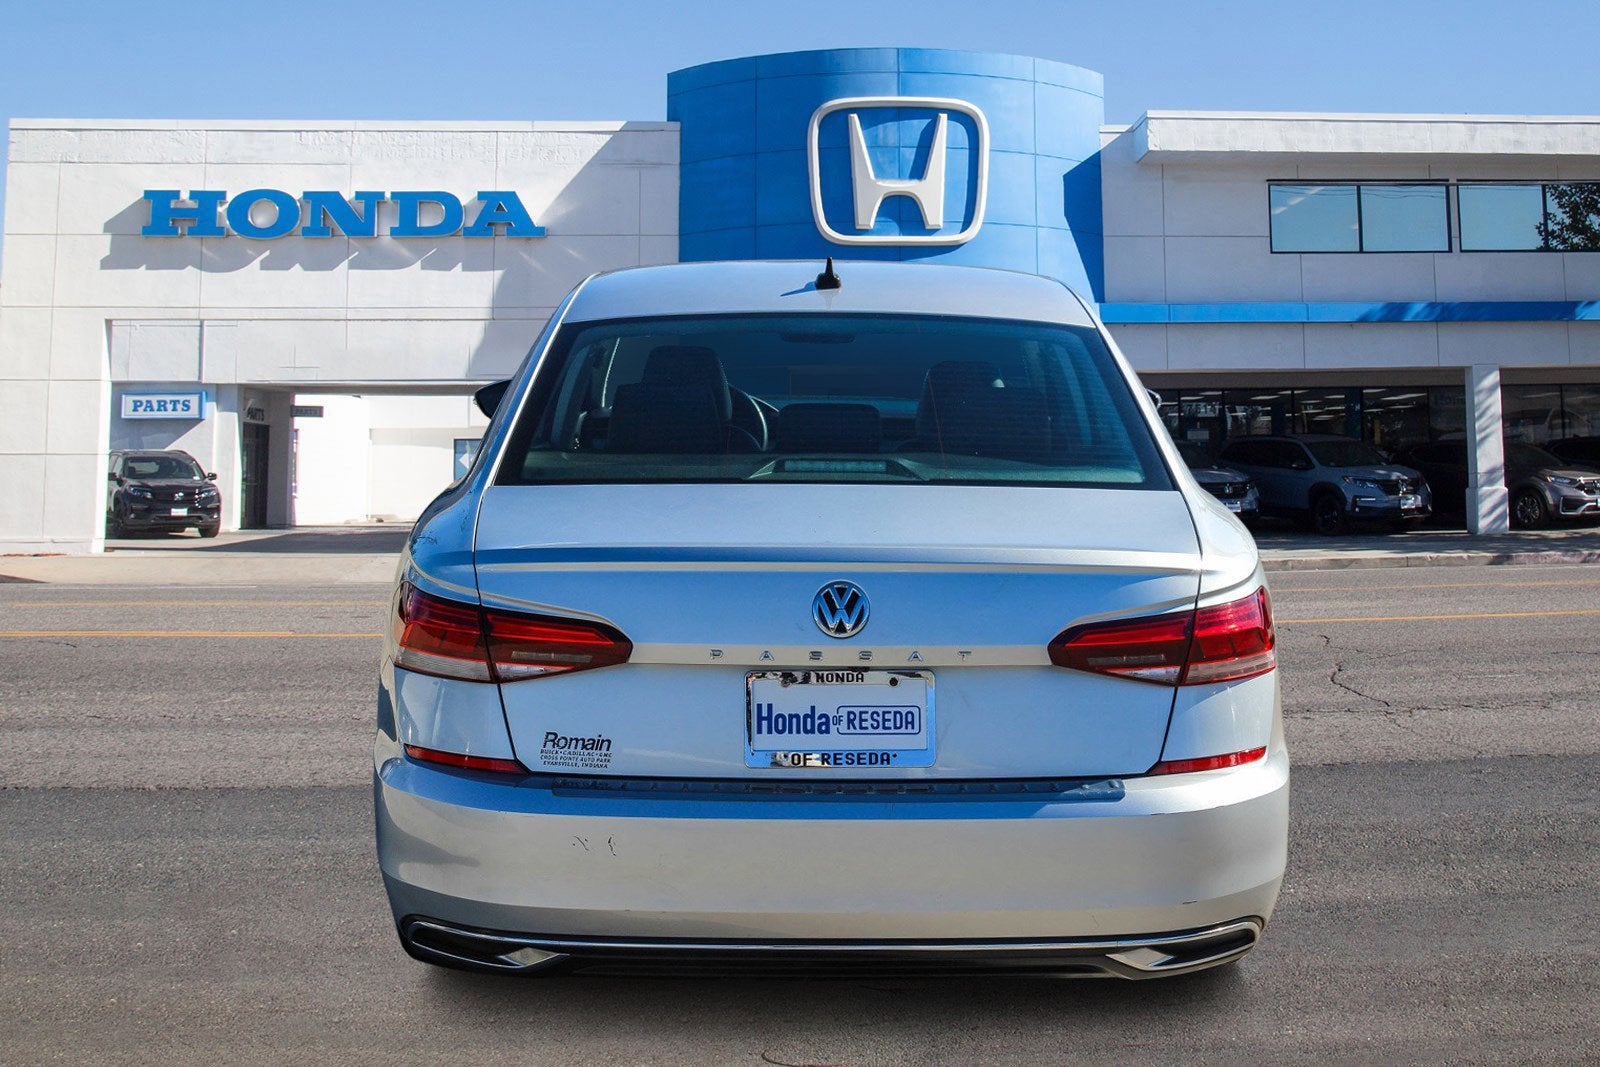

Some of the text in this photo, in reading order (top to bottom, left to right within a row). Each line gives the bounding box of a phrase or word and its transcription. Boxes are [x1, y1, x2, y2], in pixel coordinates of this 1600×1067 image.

[142, 189, 548, 238] HONDA
[131, 399, 192, 413] PARTS
[709, 650, 972, 661] PASSAT
[756, 703, 915, 735] Honda OF RESEDA
[543, 731, 612, 751] Romain
[791, 752, 891, 766] OF RESEDA
